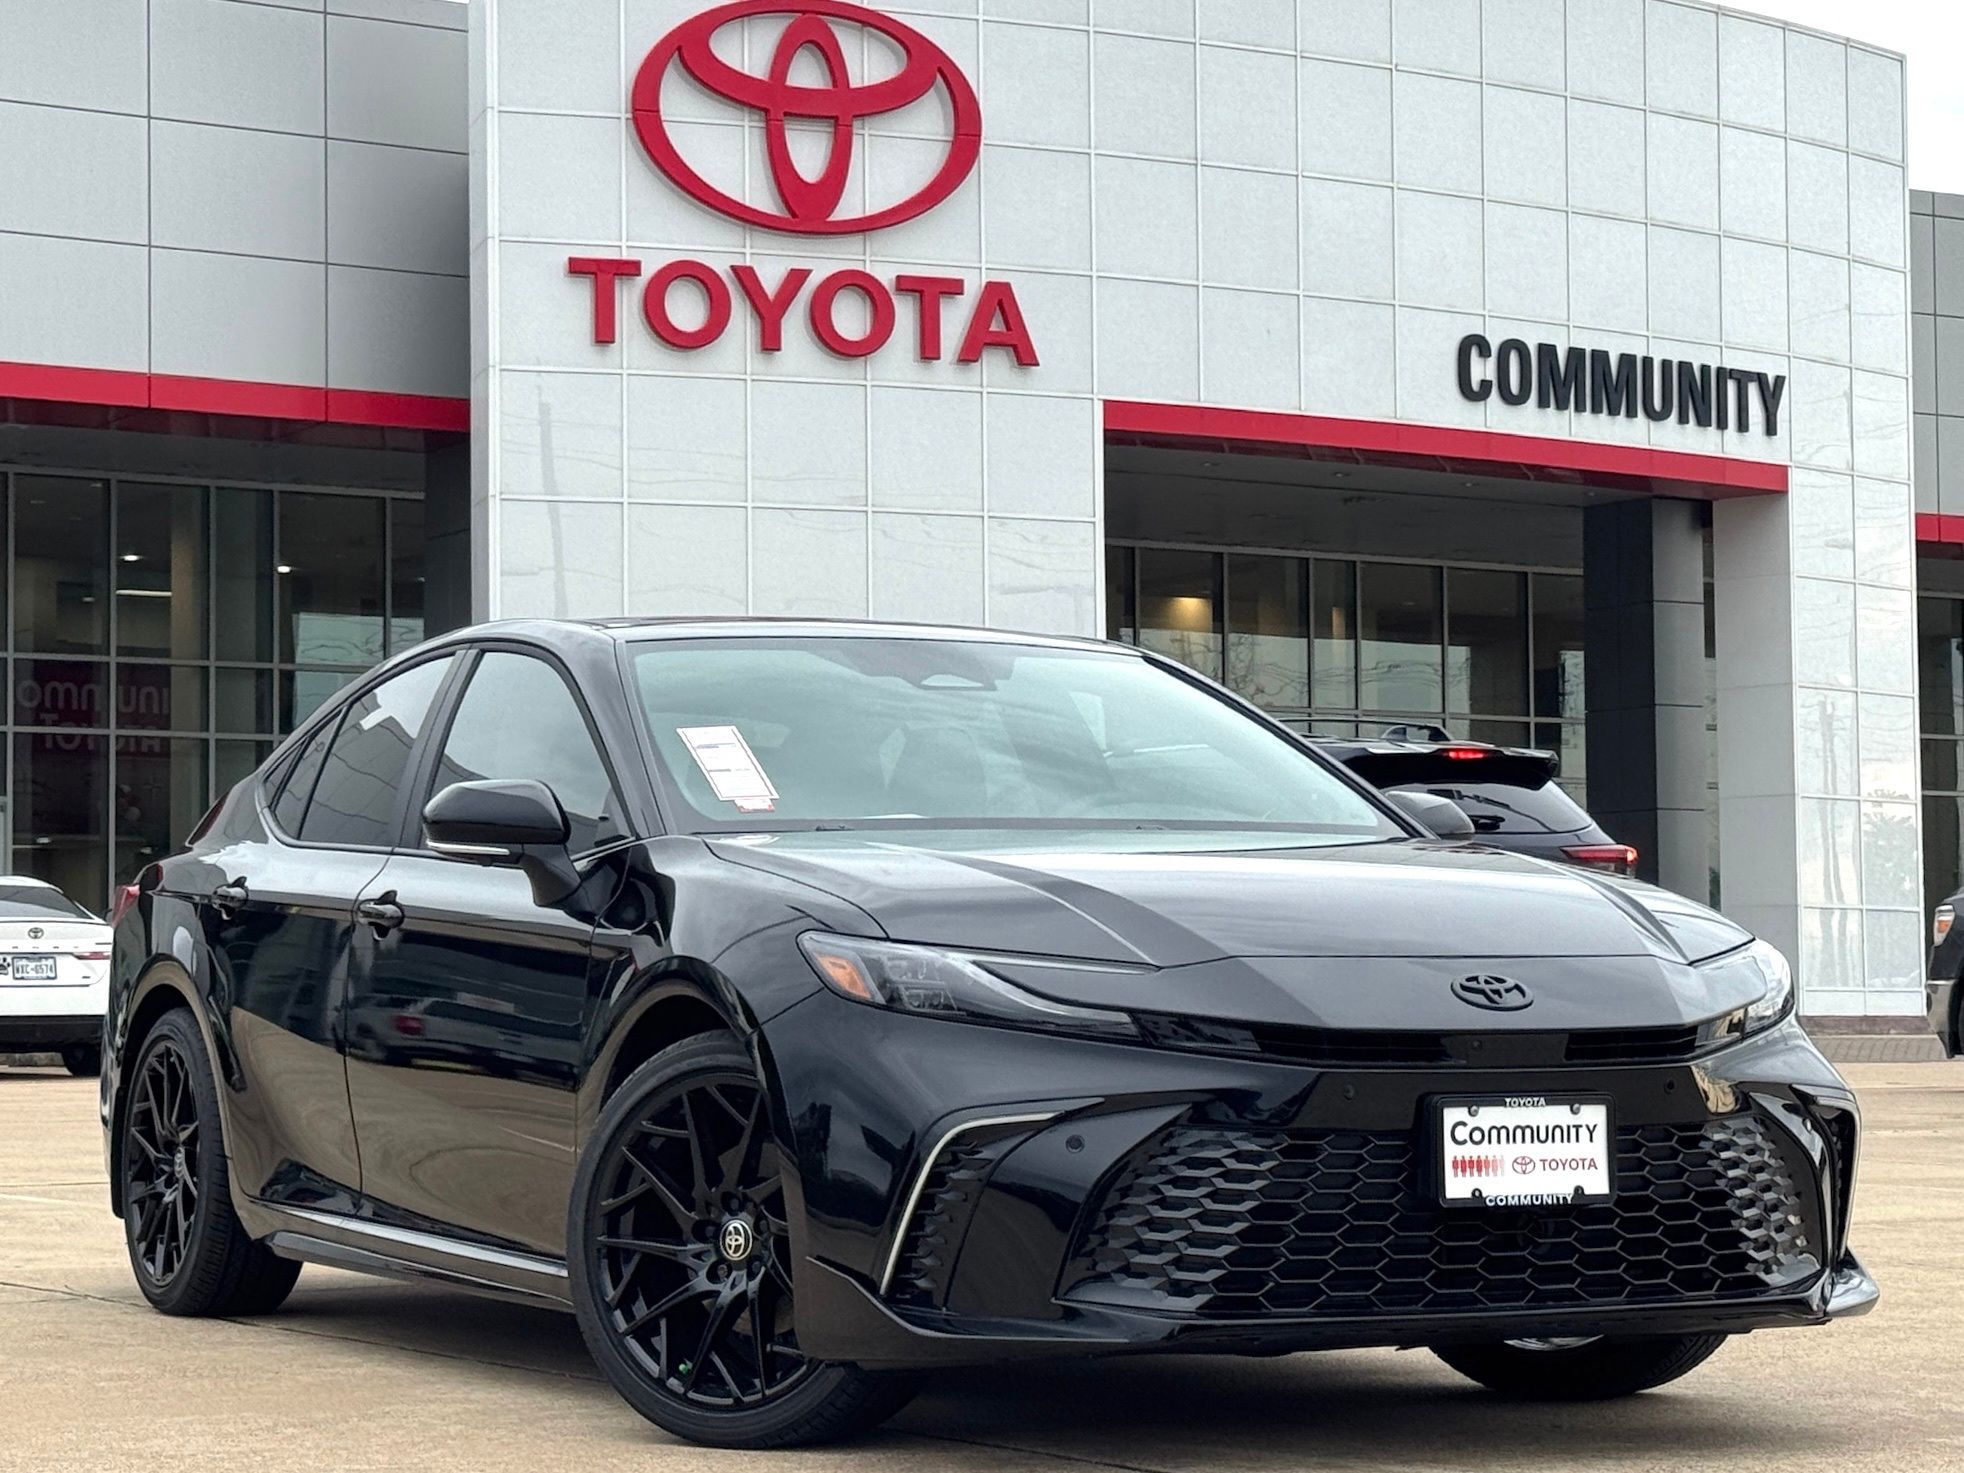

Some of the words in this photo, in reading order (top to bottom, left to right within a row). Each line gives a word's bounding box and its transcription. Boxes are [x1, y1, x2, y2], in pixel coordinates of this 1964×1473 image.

[567, 256, 1040, 367] TOYOTA
[1457, 333, 1787, 437] COMMUNITY
[1504, 1097, 1546, 1108] TOYOTA
[1539, 1157, 1598, 1172] TOYOTA
[1485, 1192, 1574, 1206] COMMUNITY
